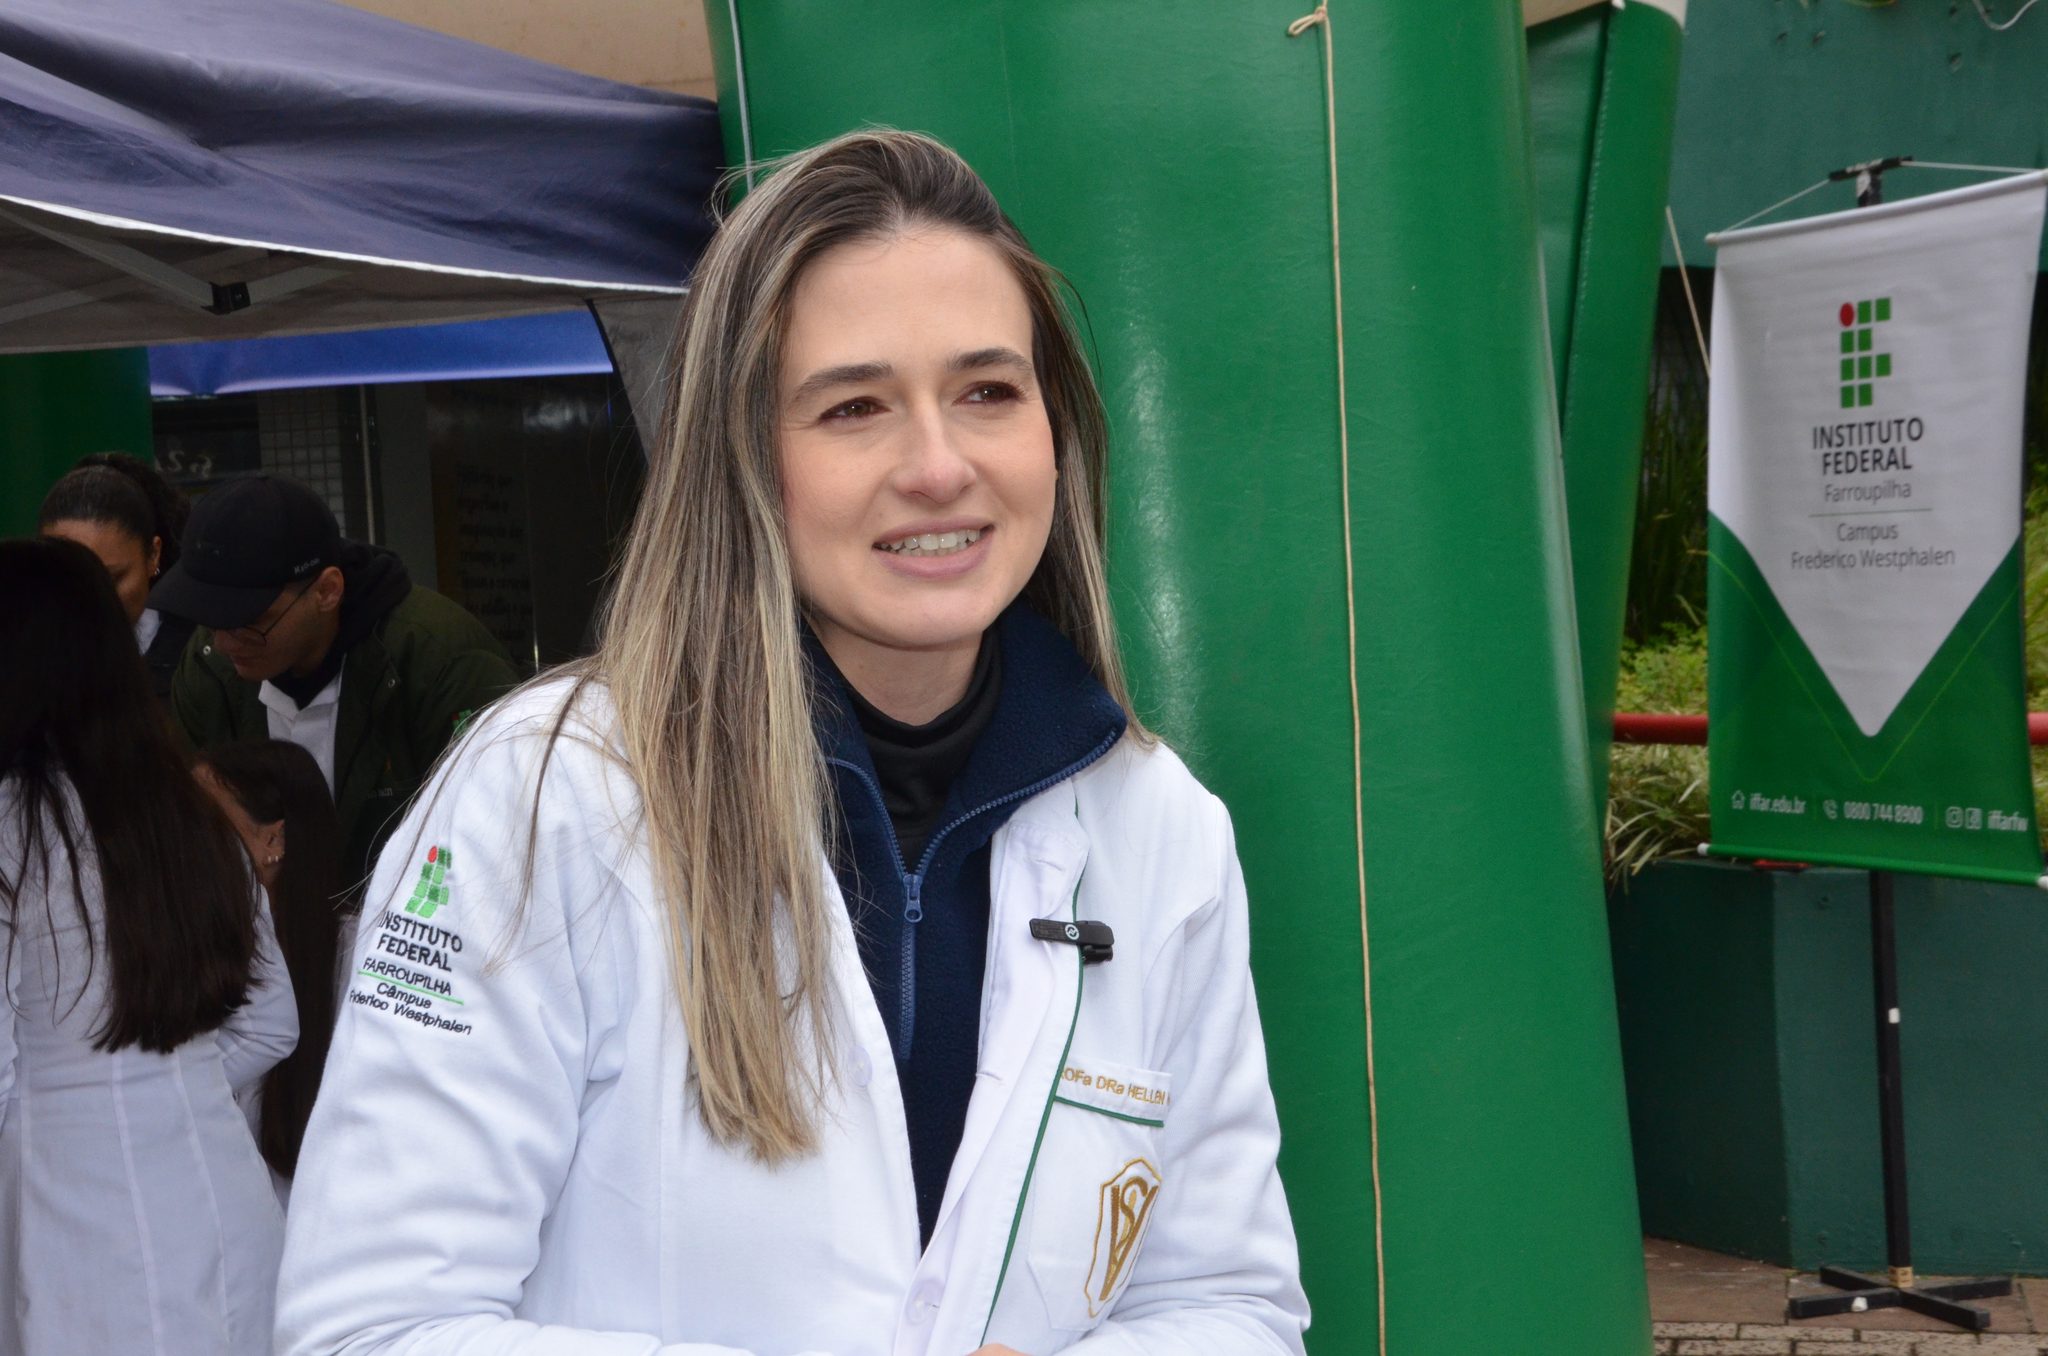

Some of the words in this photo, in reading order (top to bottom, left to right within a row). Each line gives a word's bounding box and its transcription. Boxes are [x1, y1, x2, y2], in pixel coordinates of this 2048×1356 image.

[1812, 417, 1925, 449] INSTITUTO
[1822, 447, 1913, 476] FEDERAL
[1824, 480, 1912, 504] Farroupilha
[1836, 520, 1899, 544] Campus
[1790, 550, 1857, 570] Frederico
[1861, 547, 1956, 570] Westphalen
[1843, 801, 1871, 820] 0800
[1872, 803, 1893, 822] 744
[378, 911, 463, 953] INSTITUTO
[376, 933, 452, 972] FEDERAL
[362, 957, 452, 996] FARROUPILHA
[376, 982, 432, 1009] Câmpus
[393, 1004, 473, 1036] Westphalen
